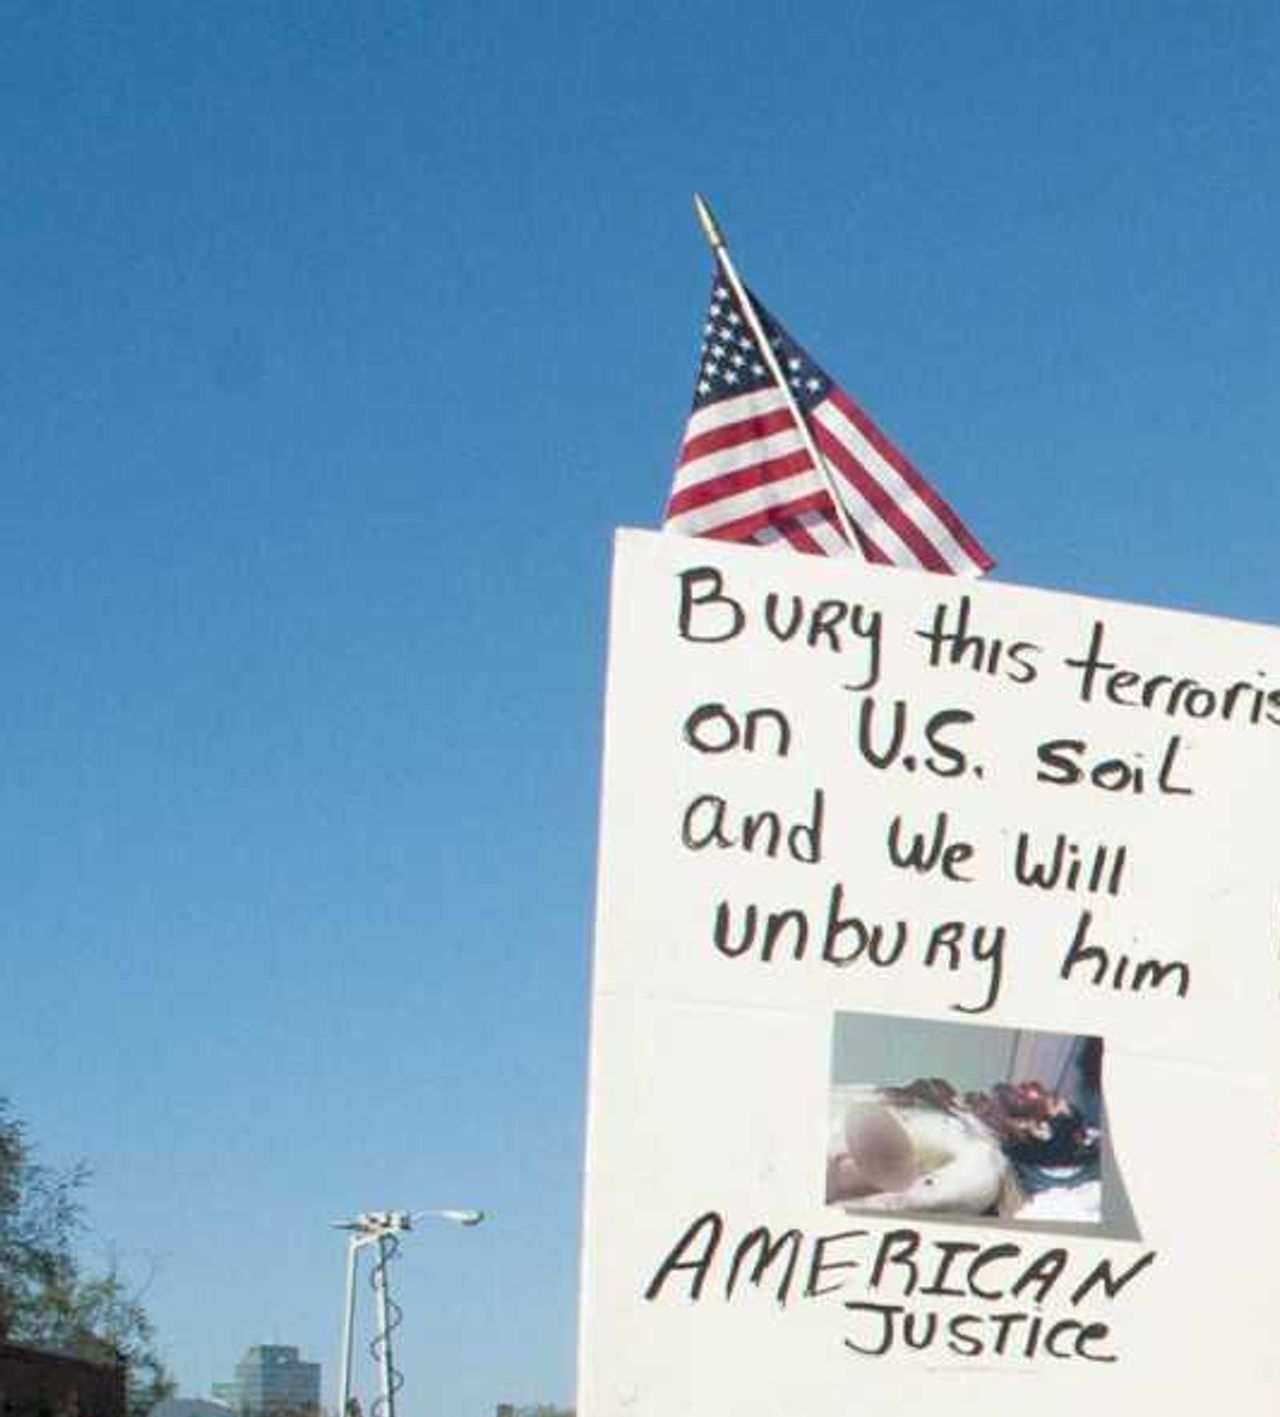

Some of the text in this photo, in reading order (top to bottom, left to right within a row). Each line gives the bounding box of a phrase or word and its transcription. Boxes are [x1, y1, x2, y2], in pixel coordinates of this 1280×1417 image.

[914, 594, 1038, 684] this
[684, 702, 792, 757] on
[858, 696, 984, 778] U.S.
[681, 788, 825, 865] and
[1060, 910, 1190, 998] him
[643, 1208, 1159, 1307] AMERICAN
